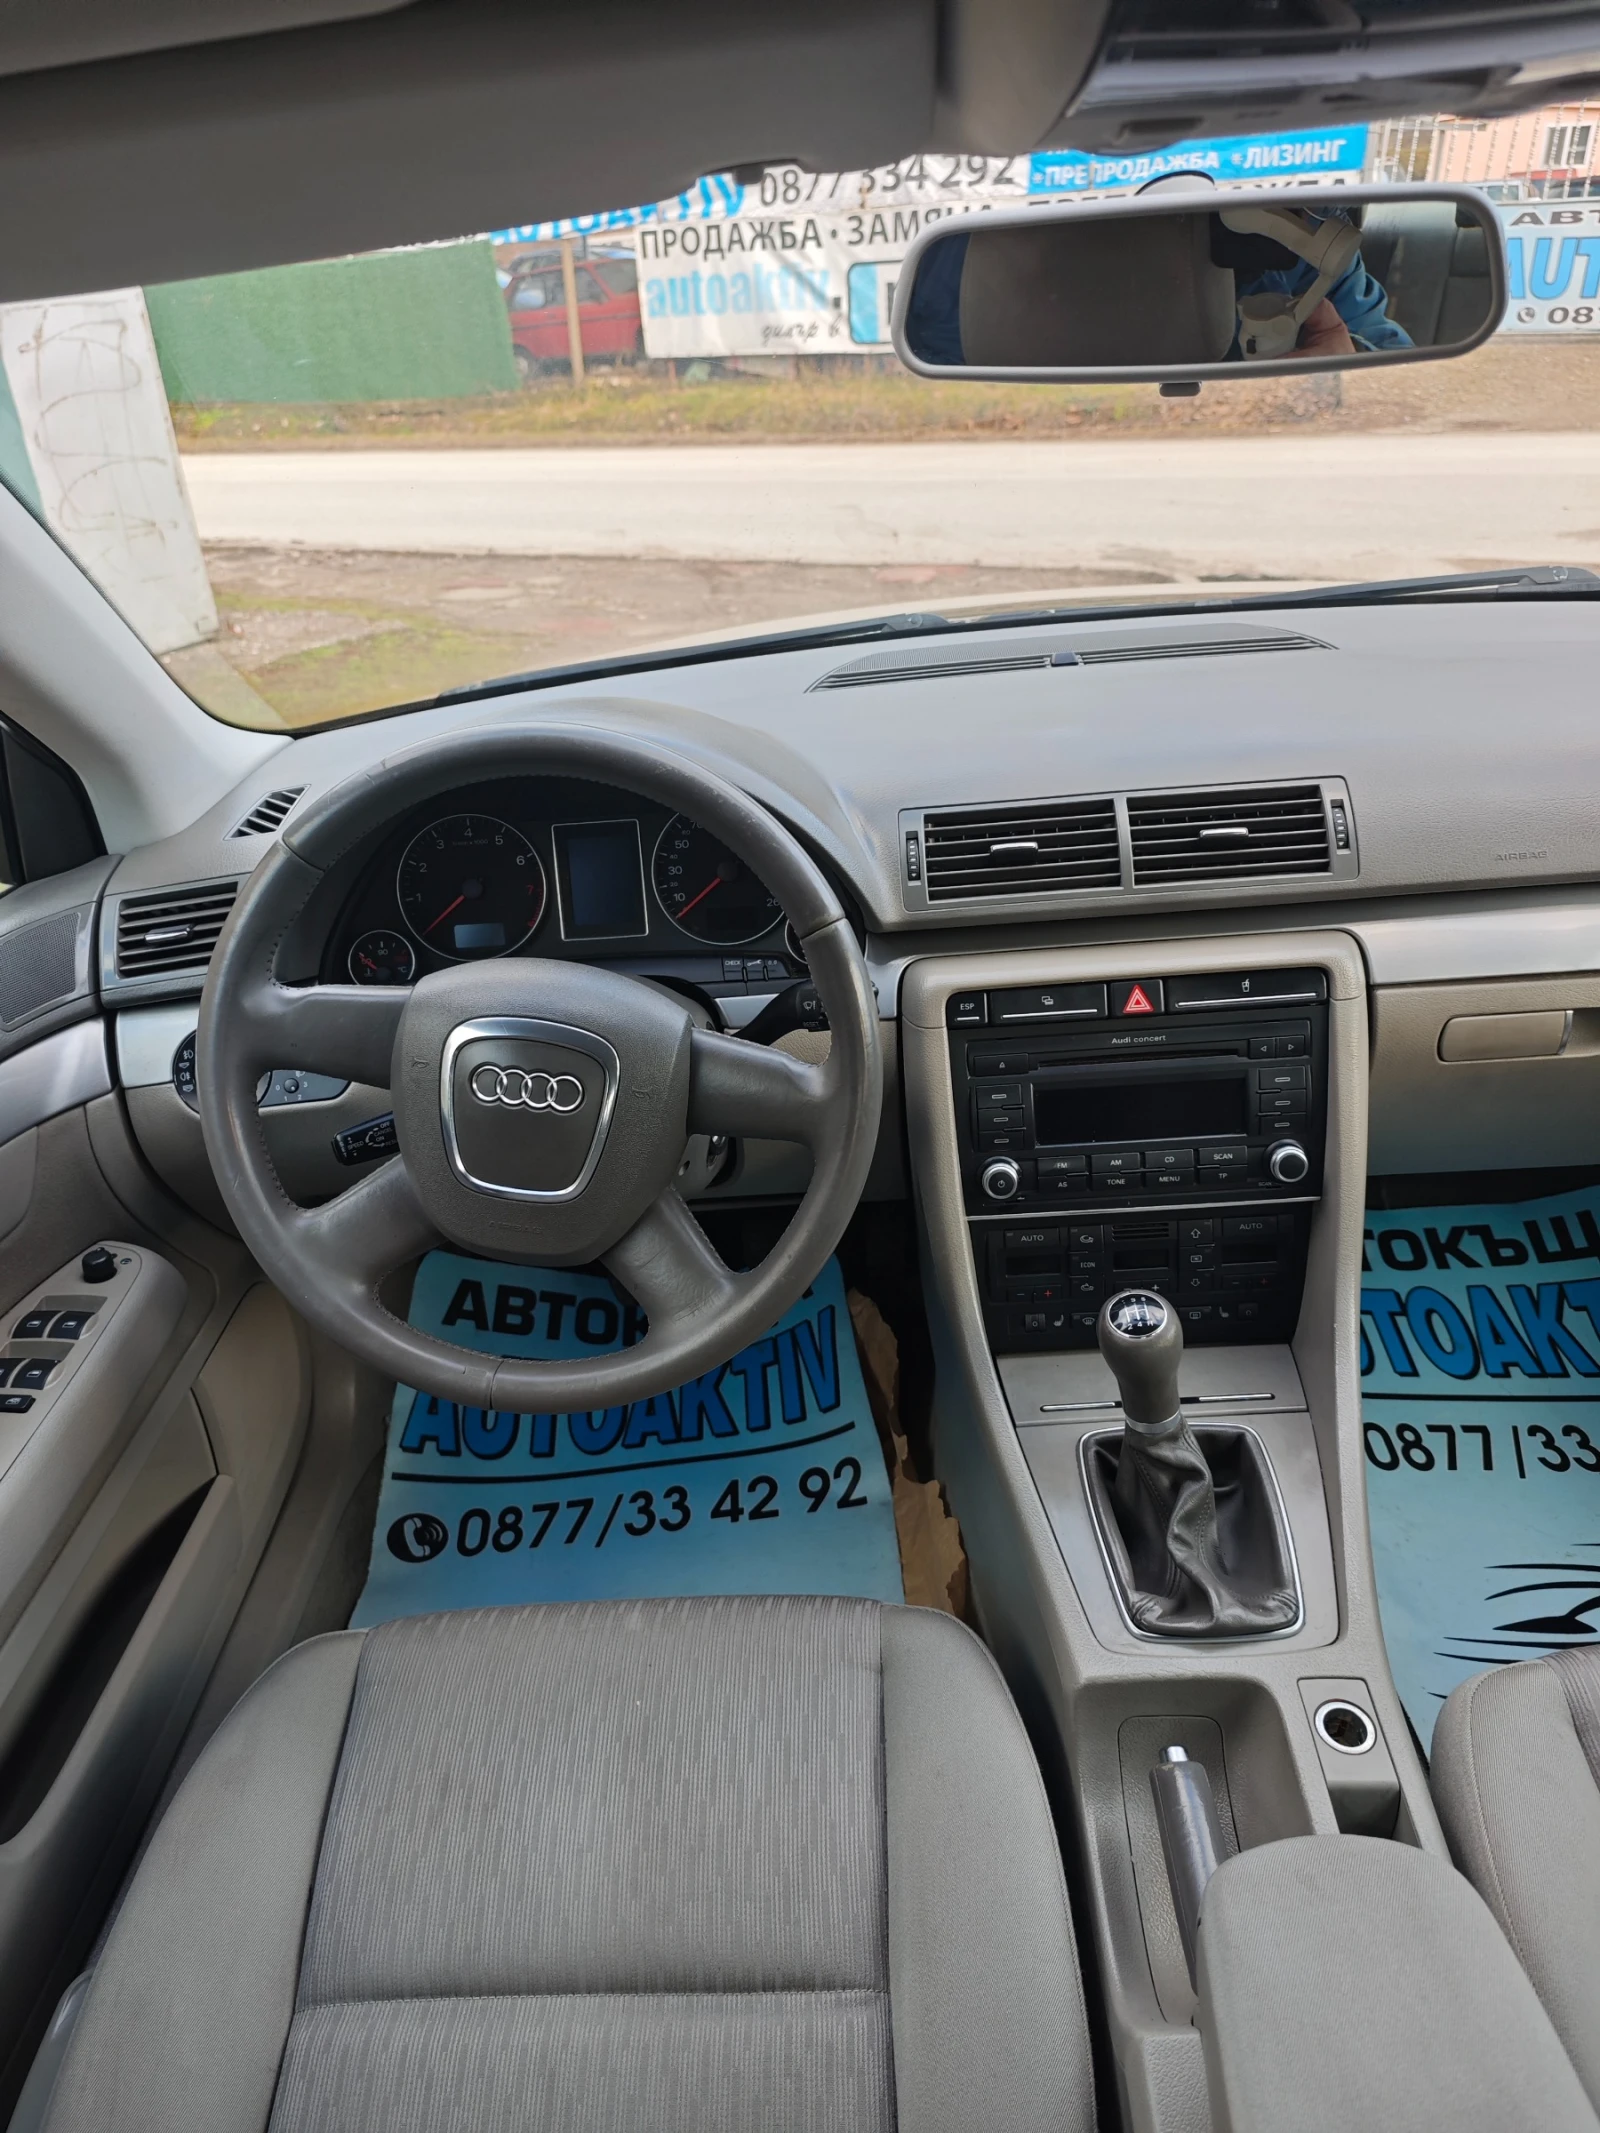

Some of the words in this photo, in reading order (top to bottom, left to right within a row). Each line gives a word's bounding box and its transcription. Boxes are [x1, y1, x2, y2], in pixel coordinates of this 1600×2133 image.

[1243, 139, 1347, 169] ЛИЗИНГ
[941, 154, 1016, 190] 292
[641, 218, 822, 262] ПРОДАЖБА
[848, 205, 991, 246] ЗАМЯ
[1547, 306, 1600, 325] 08
[463, 827, 473, 838] 4
[436, 839, 445, 850] 3
[494, 835, 504, 846] 5
[674, 839, 690, 850] 50
[516, 855, 525, 866] 6
[1494, 851, 1548, 862] AIRBAG
[419, 862, 428, 873] 2
[667, 866, 683, 876] 30
[673, 892, 686, 903] 10
[766, 897, 781, 907] 26
[959, 1002, 976, 1011] ESP
[1111, 1036, 1131, 1045] Audi
[1133, 1034, 1167, 1044] concert
[380, 1121, 391, 1129] OFF
[1056, 1161, 1068, 1169] FM
[1110, 1158, 1122, 1166] AM
[1213, 1152, 1234, 1160] SCAN
[1057, 1181, 1068, 1189] AS
[1106, 1178, 1126, 1186] TONE
[1158, 1175, 1181, 1183] MENU
[1239, 1222, 1263, 1231] AUTO
[1020, 1233, 1045, 1242] AUTO
[1080, 1261, 1096, 1269] ECON
[441, 1279, 651, 1347] АВТОК
[1361, 1276, 1600, 1380] TOAK
[455, 1485, 692, 1557] 0877/33
[710, 1475, 780, 1524] 42
[798, 1456, 869, 1514] 92
